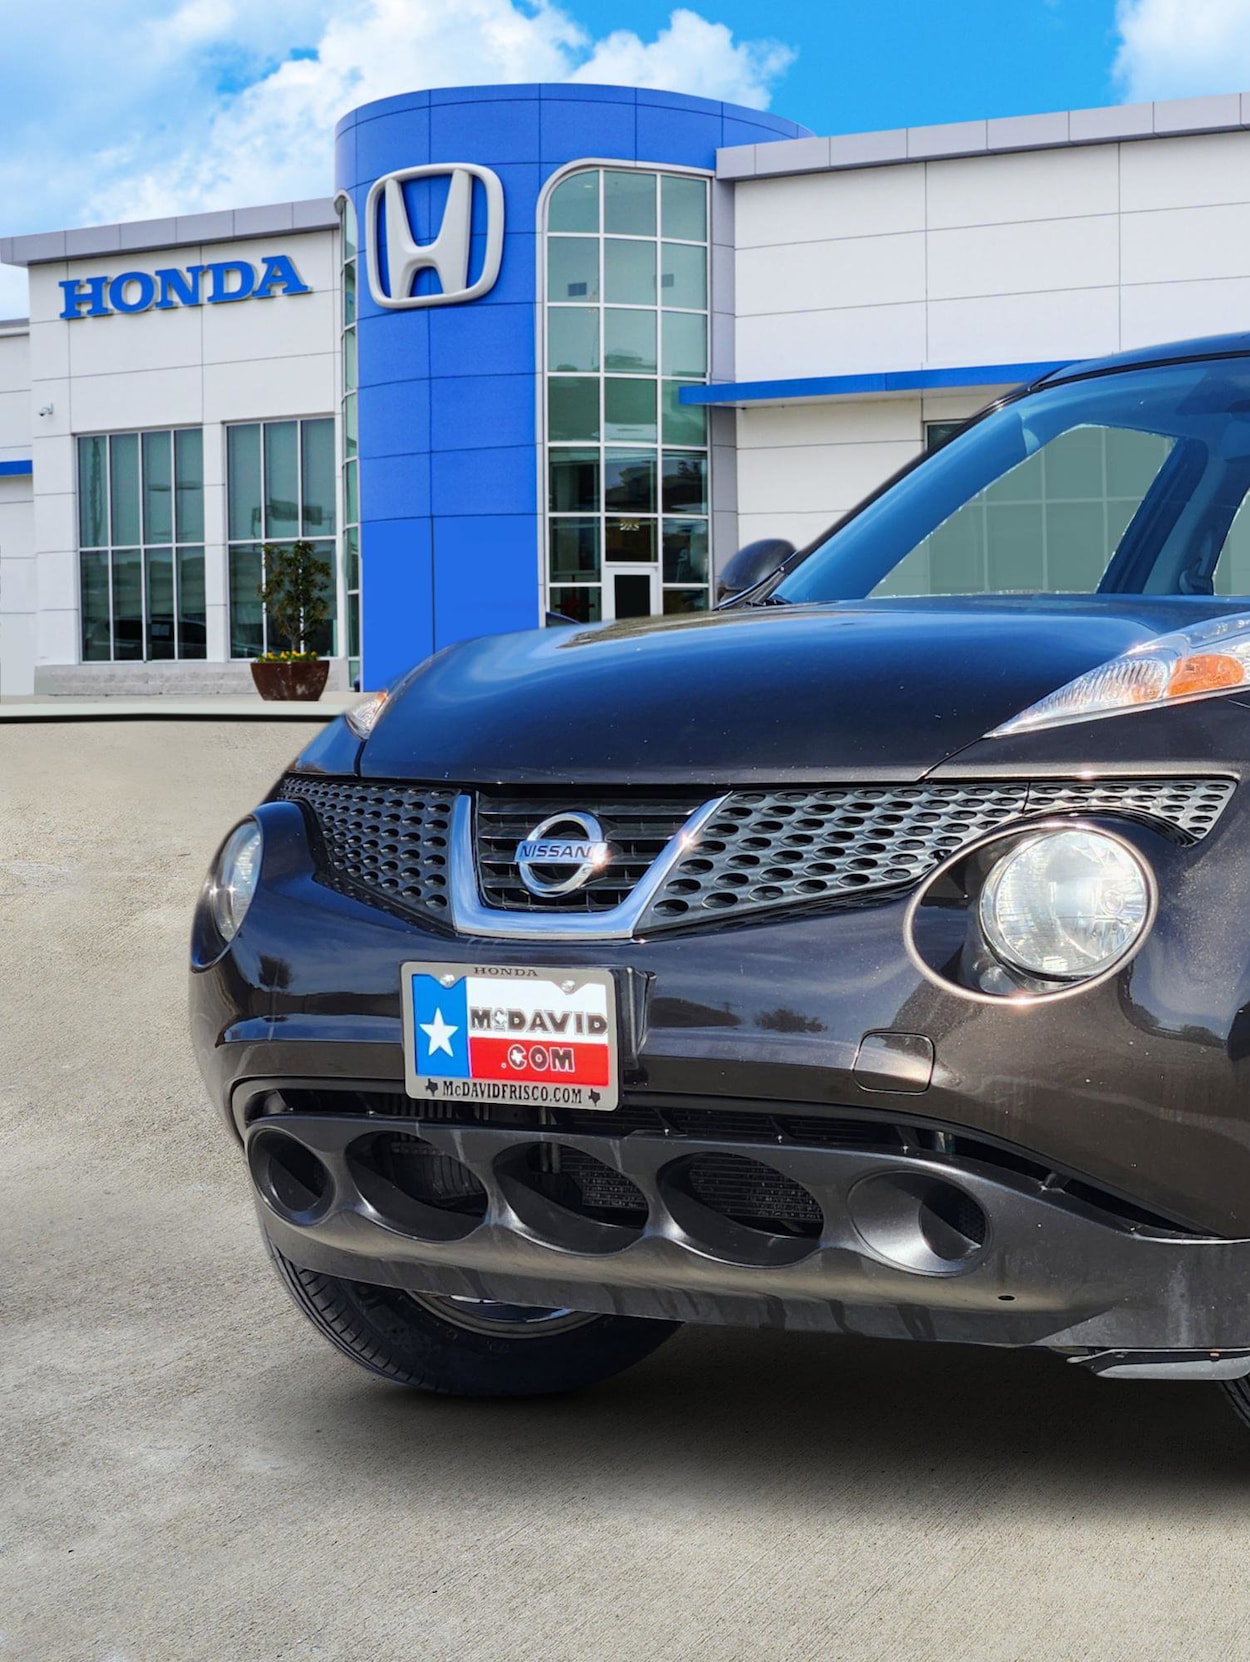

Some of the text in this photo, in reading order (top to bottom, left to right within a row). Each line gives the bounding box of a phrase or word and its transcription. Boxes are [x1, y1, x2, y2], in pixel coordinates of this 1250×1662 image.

[59, 254, 314, 320] HONDA
[519, 845, 592, 859] NISSAN
[473, 967, 538, 977] HONDA
[501, 1045, 576, 1073] .COM
[442, 1080, 583, 1104] McDAVIDFRISCO.COM
